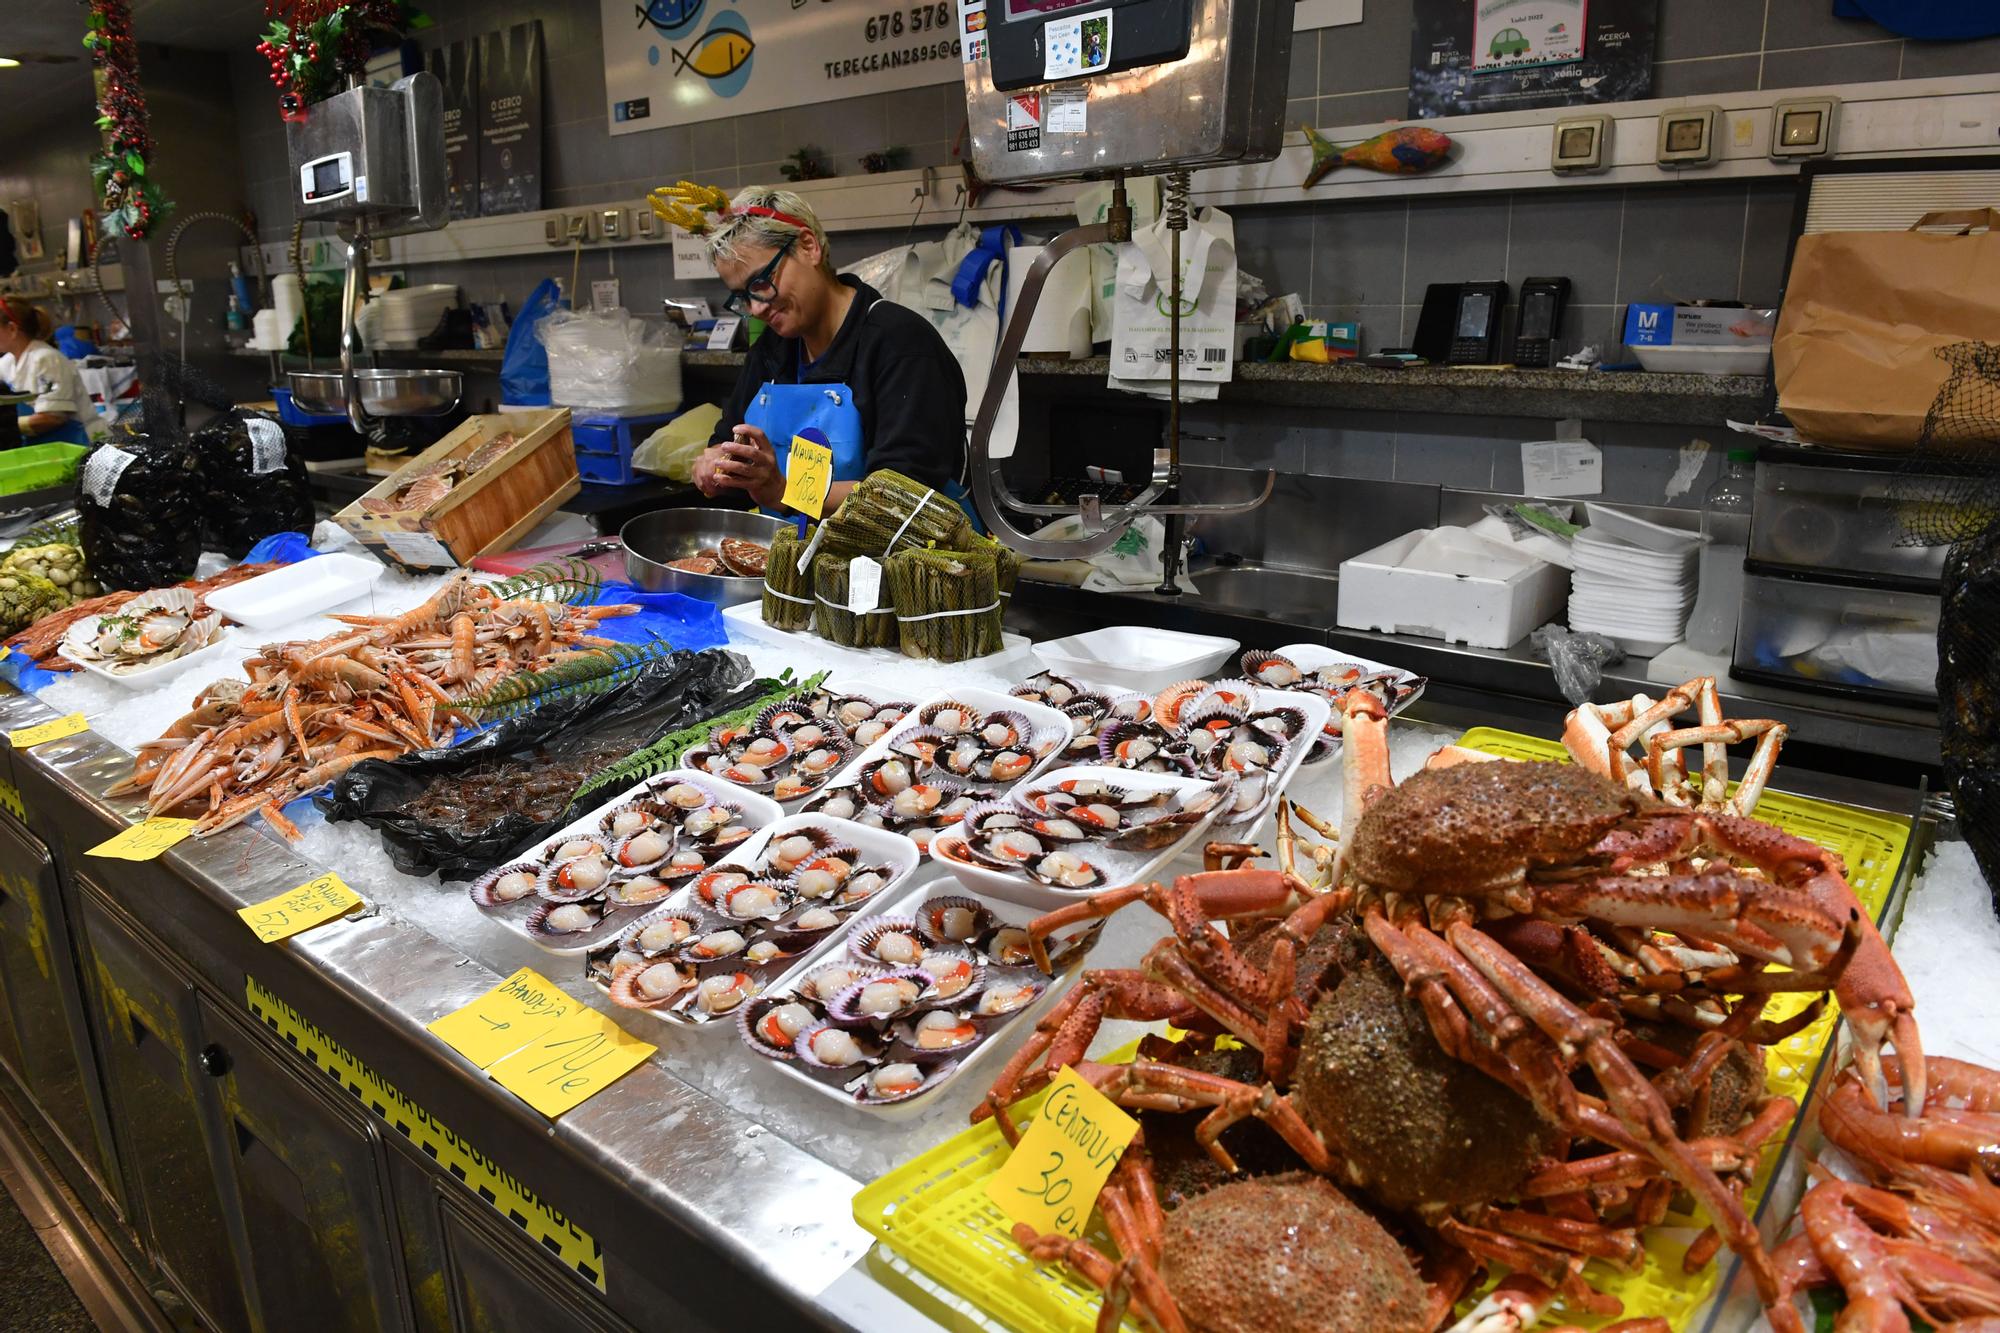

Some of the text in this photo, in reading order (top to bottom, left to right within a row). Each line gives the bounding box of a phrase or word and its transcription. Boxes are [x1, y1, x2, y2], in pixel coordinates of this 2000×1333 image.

[865, 11, 904, 43] 678
[910, 2, 949, 34] 378
[1599, 31, 1630, 41] ACERGA
[969, 38, 987, 60] JCB
[498, 96, 522, 110] CERCO
[444, 109, 461, 121] ERCO
[1638, 311, 1659, 328] M
[1698, 322, 1722, 330] protect
[498, 973, 567, 1018] BANDEJA
